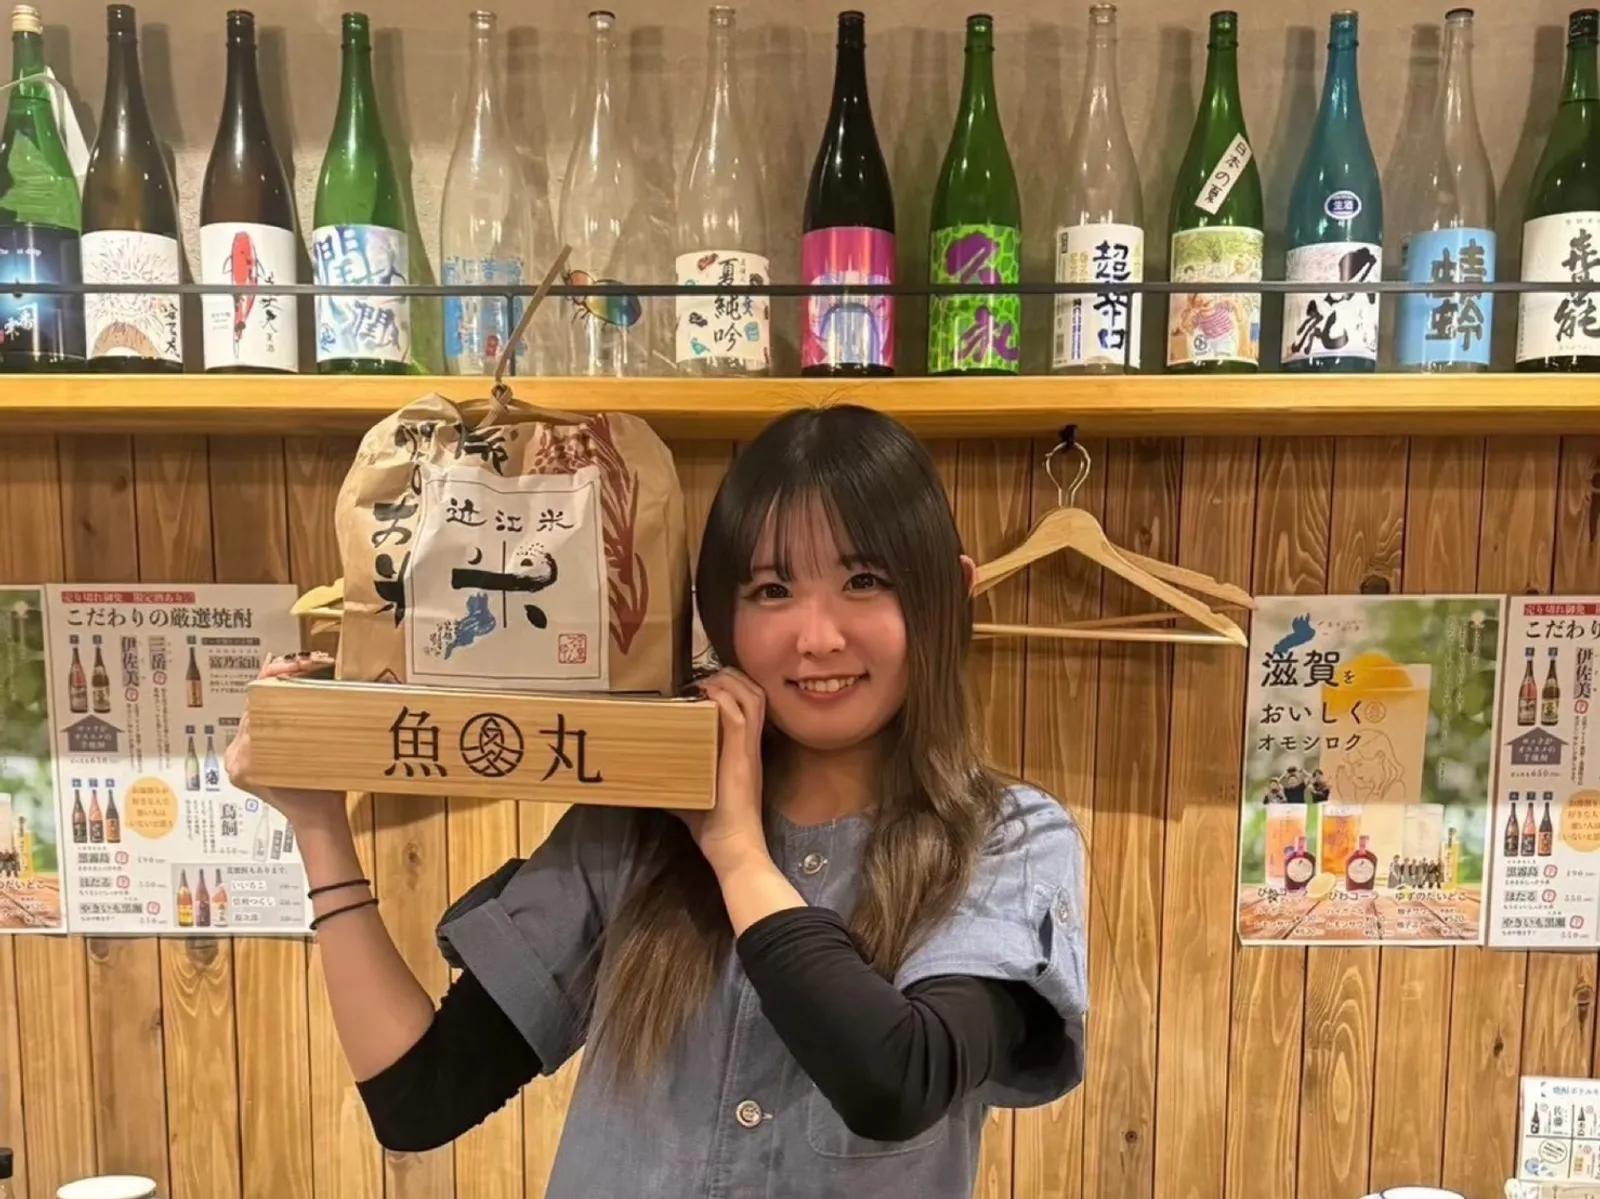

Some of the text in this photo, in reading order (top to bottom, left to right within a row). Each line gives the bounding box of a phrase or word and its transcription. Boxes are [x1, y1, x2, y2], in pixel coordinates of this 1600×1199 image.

[1203, 141, 1248, 204] 日本の夏
[713, 257, 742, 352] 夏純吟
[445, 497, 577, 534] 近江米
[67, 607, 253, 629] こだわりの厳選焼酎
[1260, 650, 1356, 688] 滋賀を
[1259, 700, 1362, 725] おいしく
[384, 705, 604, 784] 魚 丸
[1257, 733, 1362, 752] オモシロク
